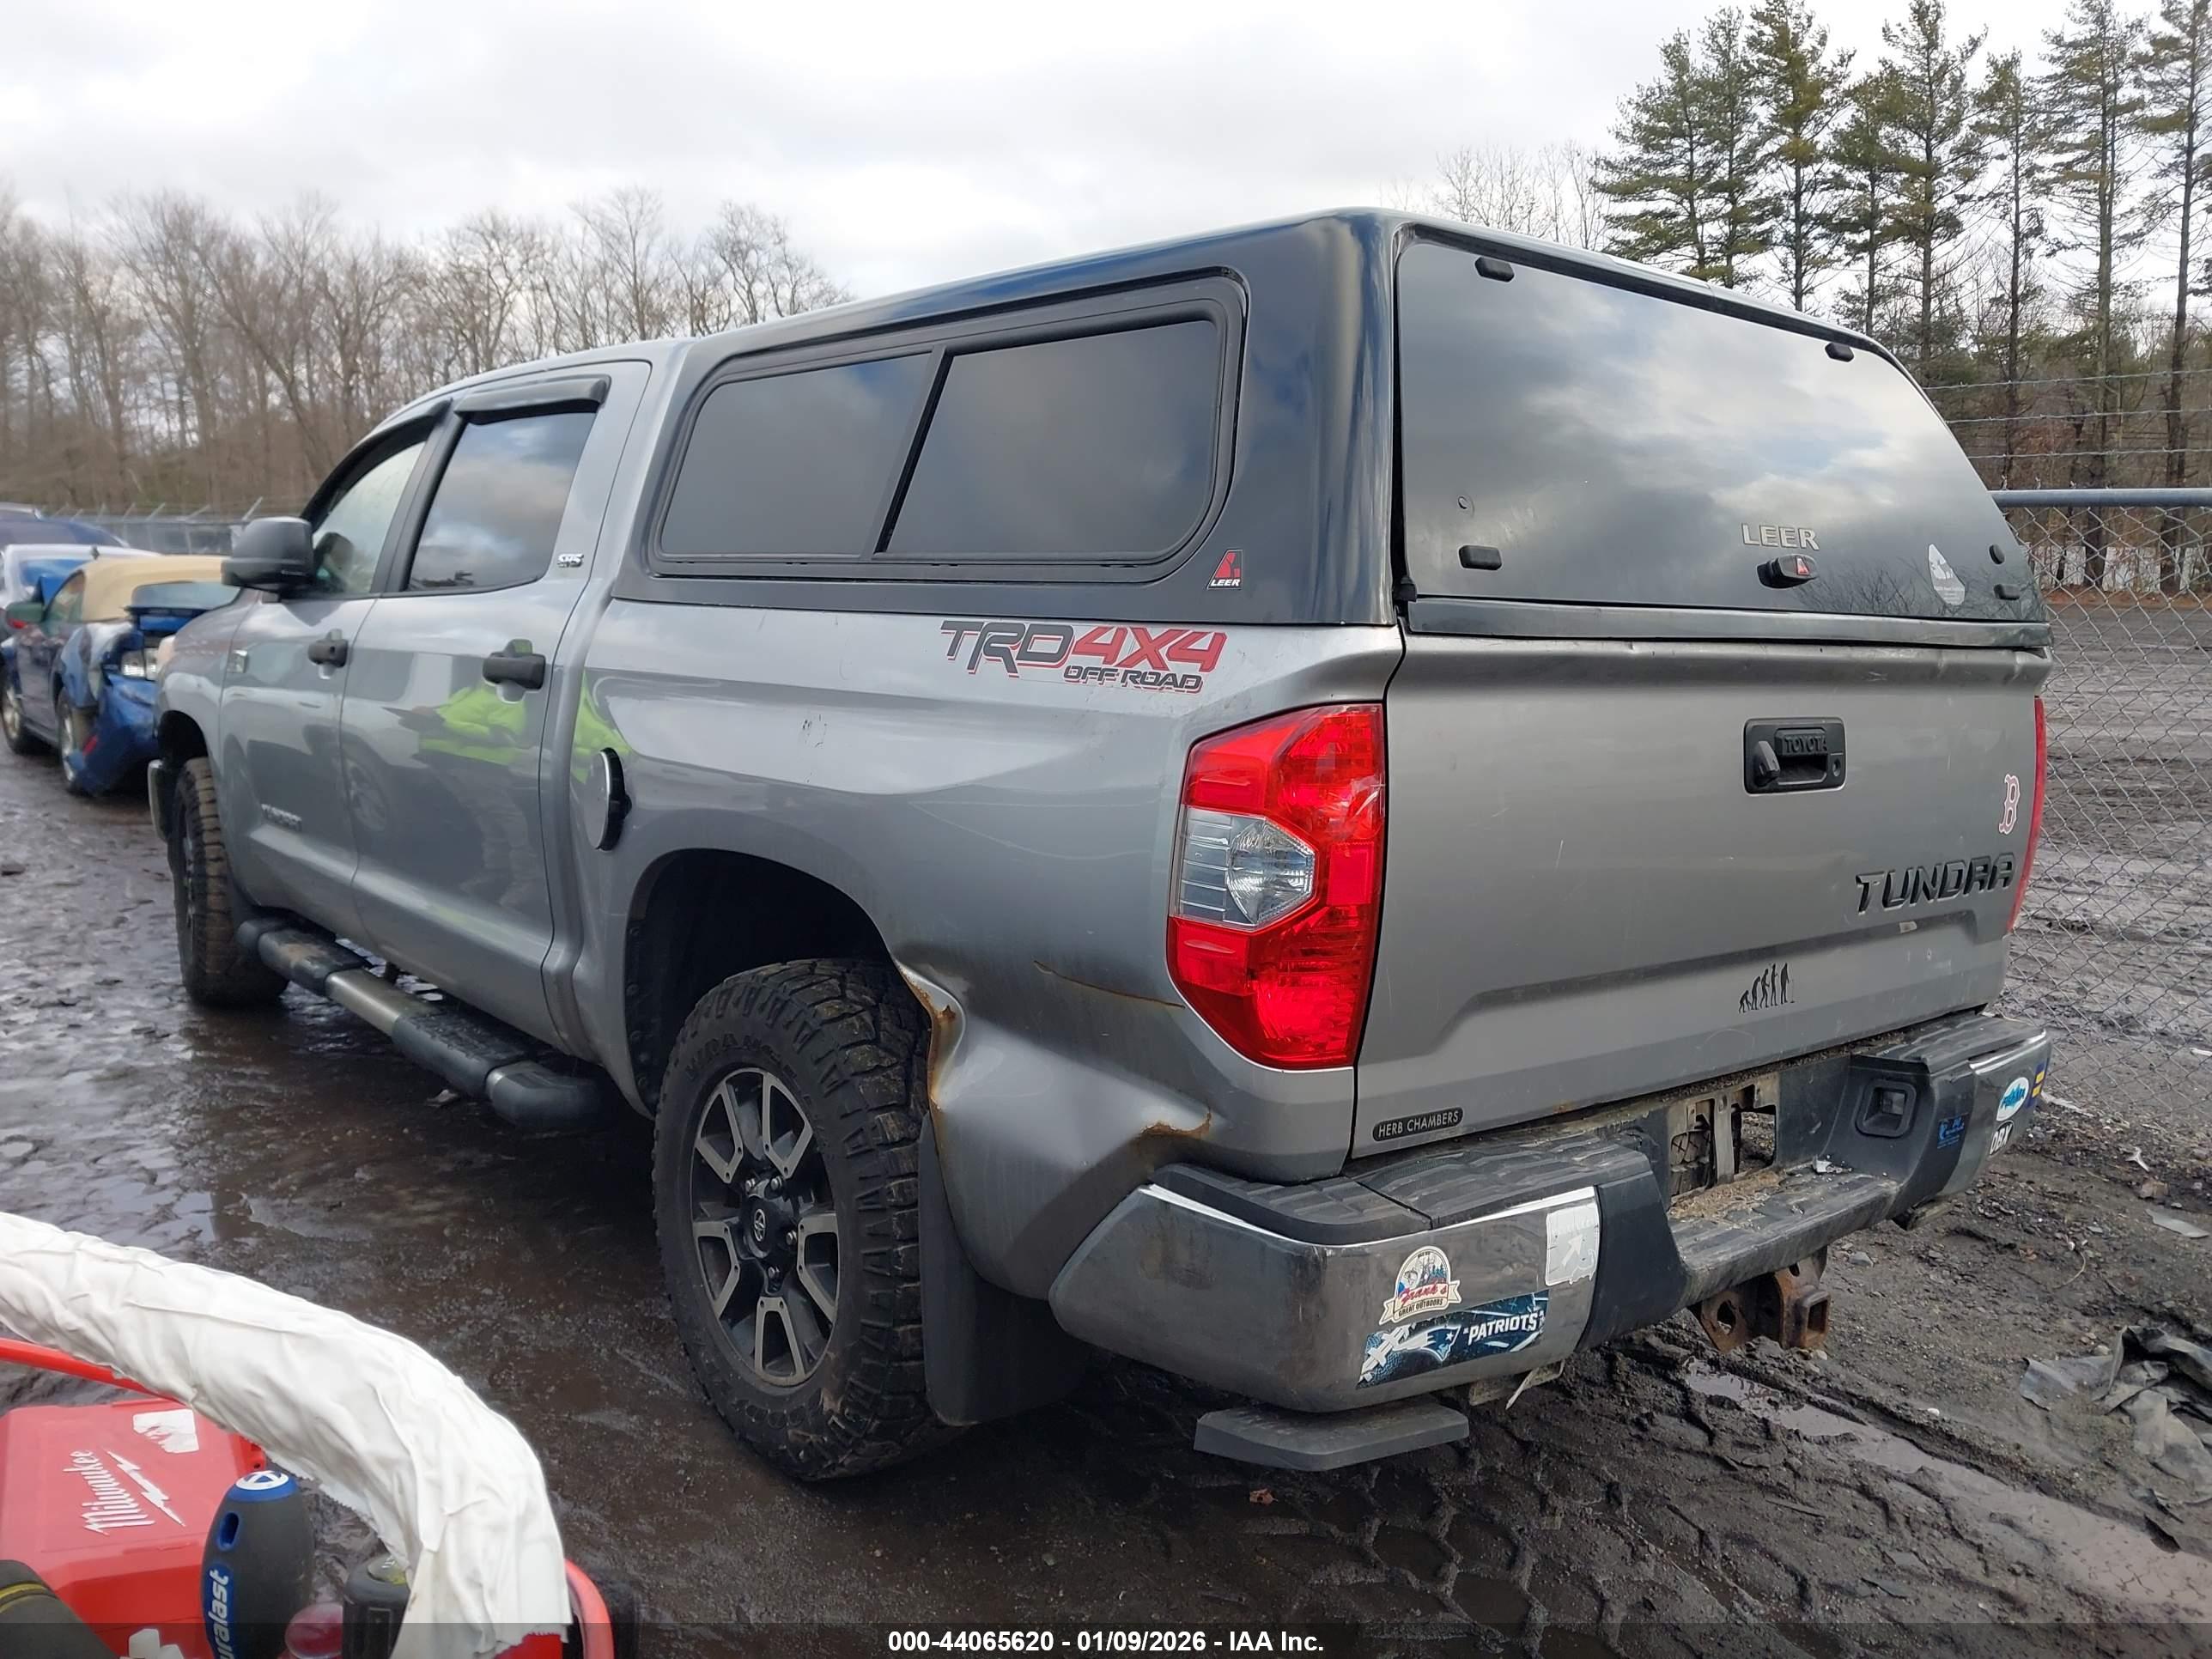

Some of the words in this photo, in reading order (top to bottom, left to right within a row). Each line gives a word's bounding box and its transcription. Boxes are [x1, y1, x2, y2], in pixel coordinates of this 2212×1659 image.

[1741, 523, 1820, 551] LEER
[940, 621, 1074, 679] TRD
[1063, 665, 1120, 685] OFF
[1119, 669, 1203, 694] ROAD
[1784, 735, 1827, 753] TOYOTA
[1998, 774, 2021, 835] B
[1856, 852, 2015, 916] TUNDRA
[1378, 1121, 1403, 1138] HERB
[1407, 1110, 1459, 1132] CHAMBERS
[1398, 1304, 1415, 1316] GREAT
[1415, 1298, 1443, 1310] OUTDOORS
[1400, 1283, 1447, 1305] Frank's
[1464, 1312, 1538, 1346] PATRIOTS
[63, 1450, 155, 1535] Milwaukee
[208, 1569, 235, 1659] uralast
